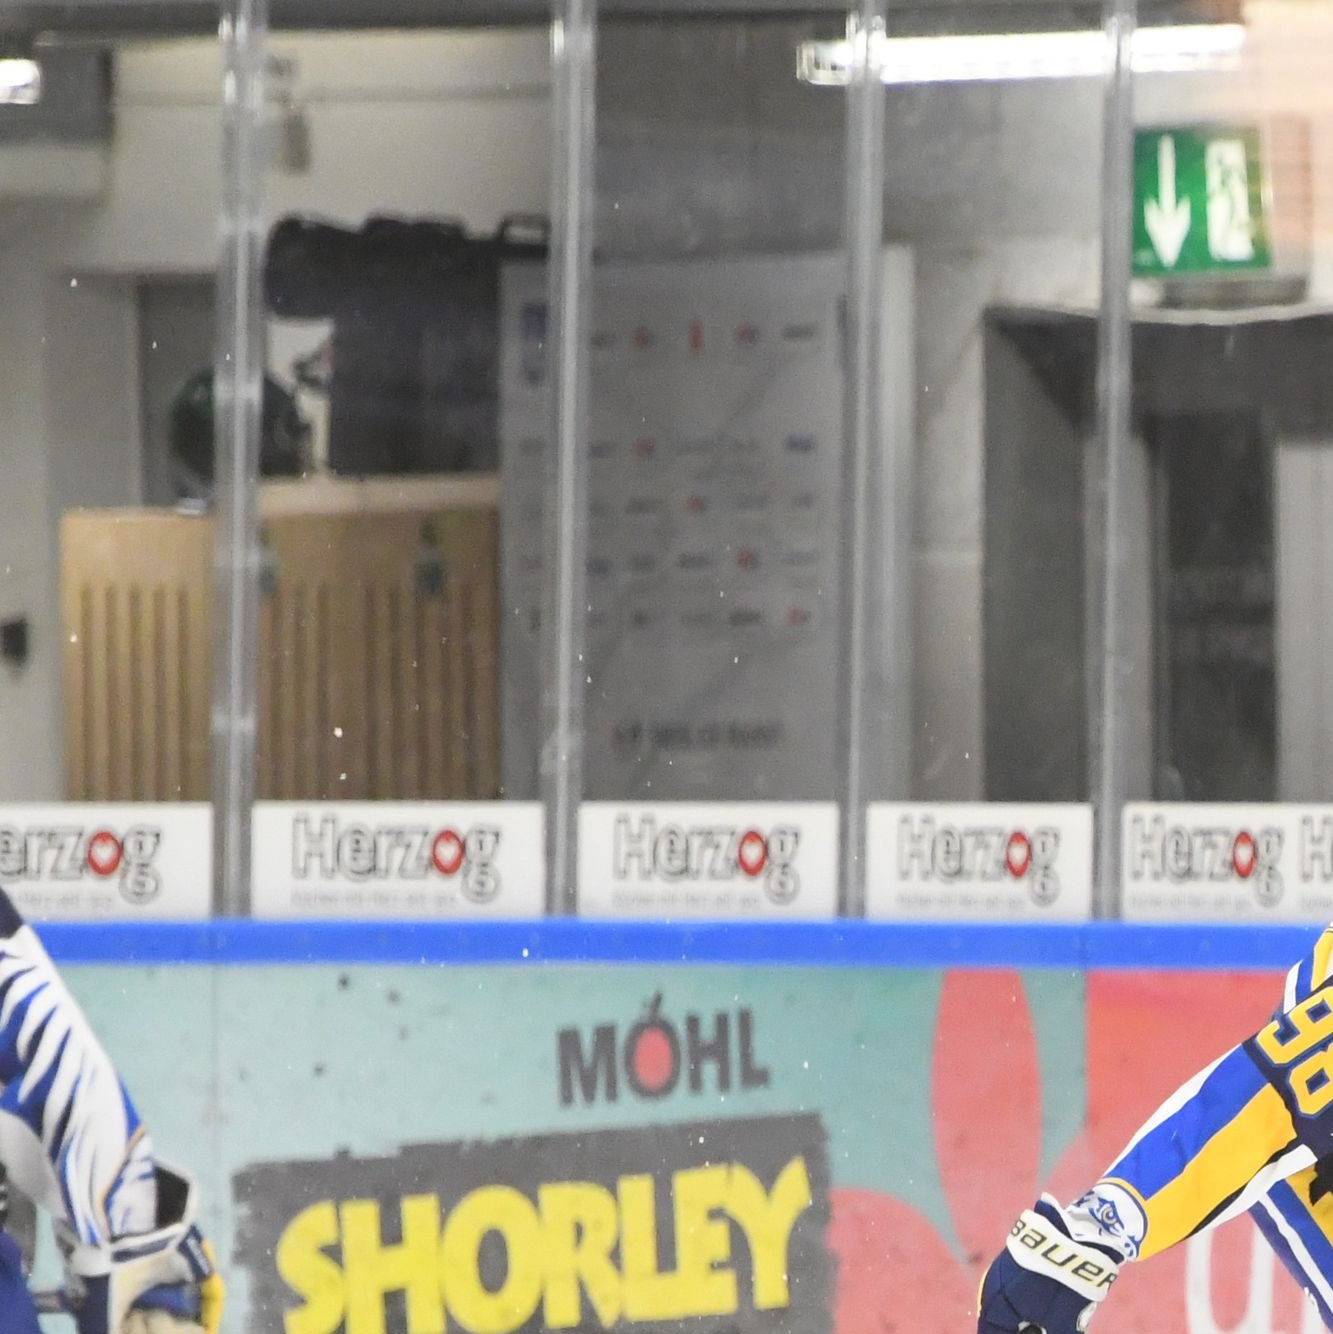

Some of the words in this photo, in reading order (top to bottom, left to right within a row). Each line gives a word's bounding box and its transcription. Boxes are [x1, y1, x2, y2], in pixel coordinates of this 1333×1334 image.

[0, 826, 163, 905] erzog
[290, 812, 502, 902] Herzog
[612, 812, 802, 905] Herzog
[897, 812, 1062, 906] Herzog
[1129, 812, 1286, 906] Herzog
